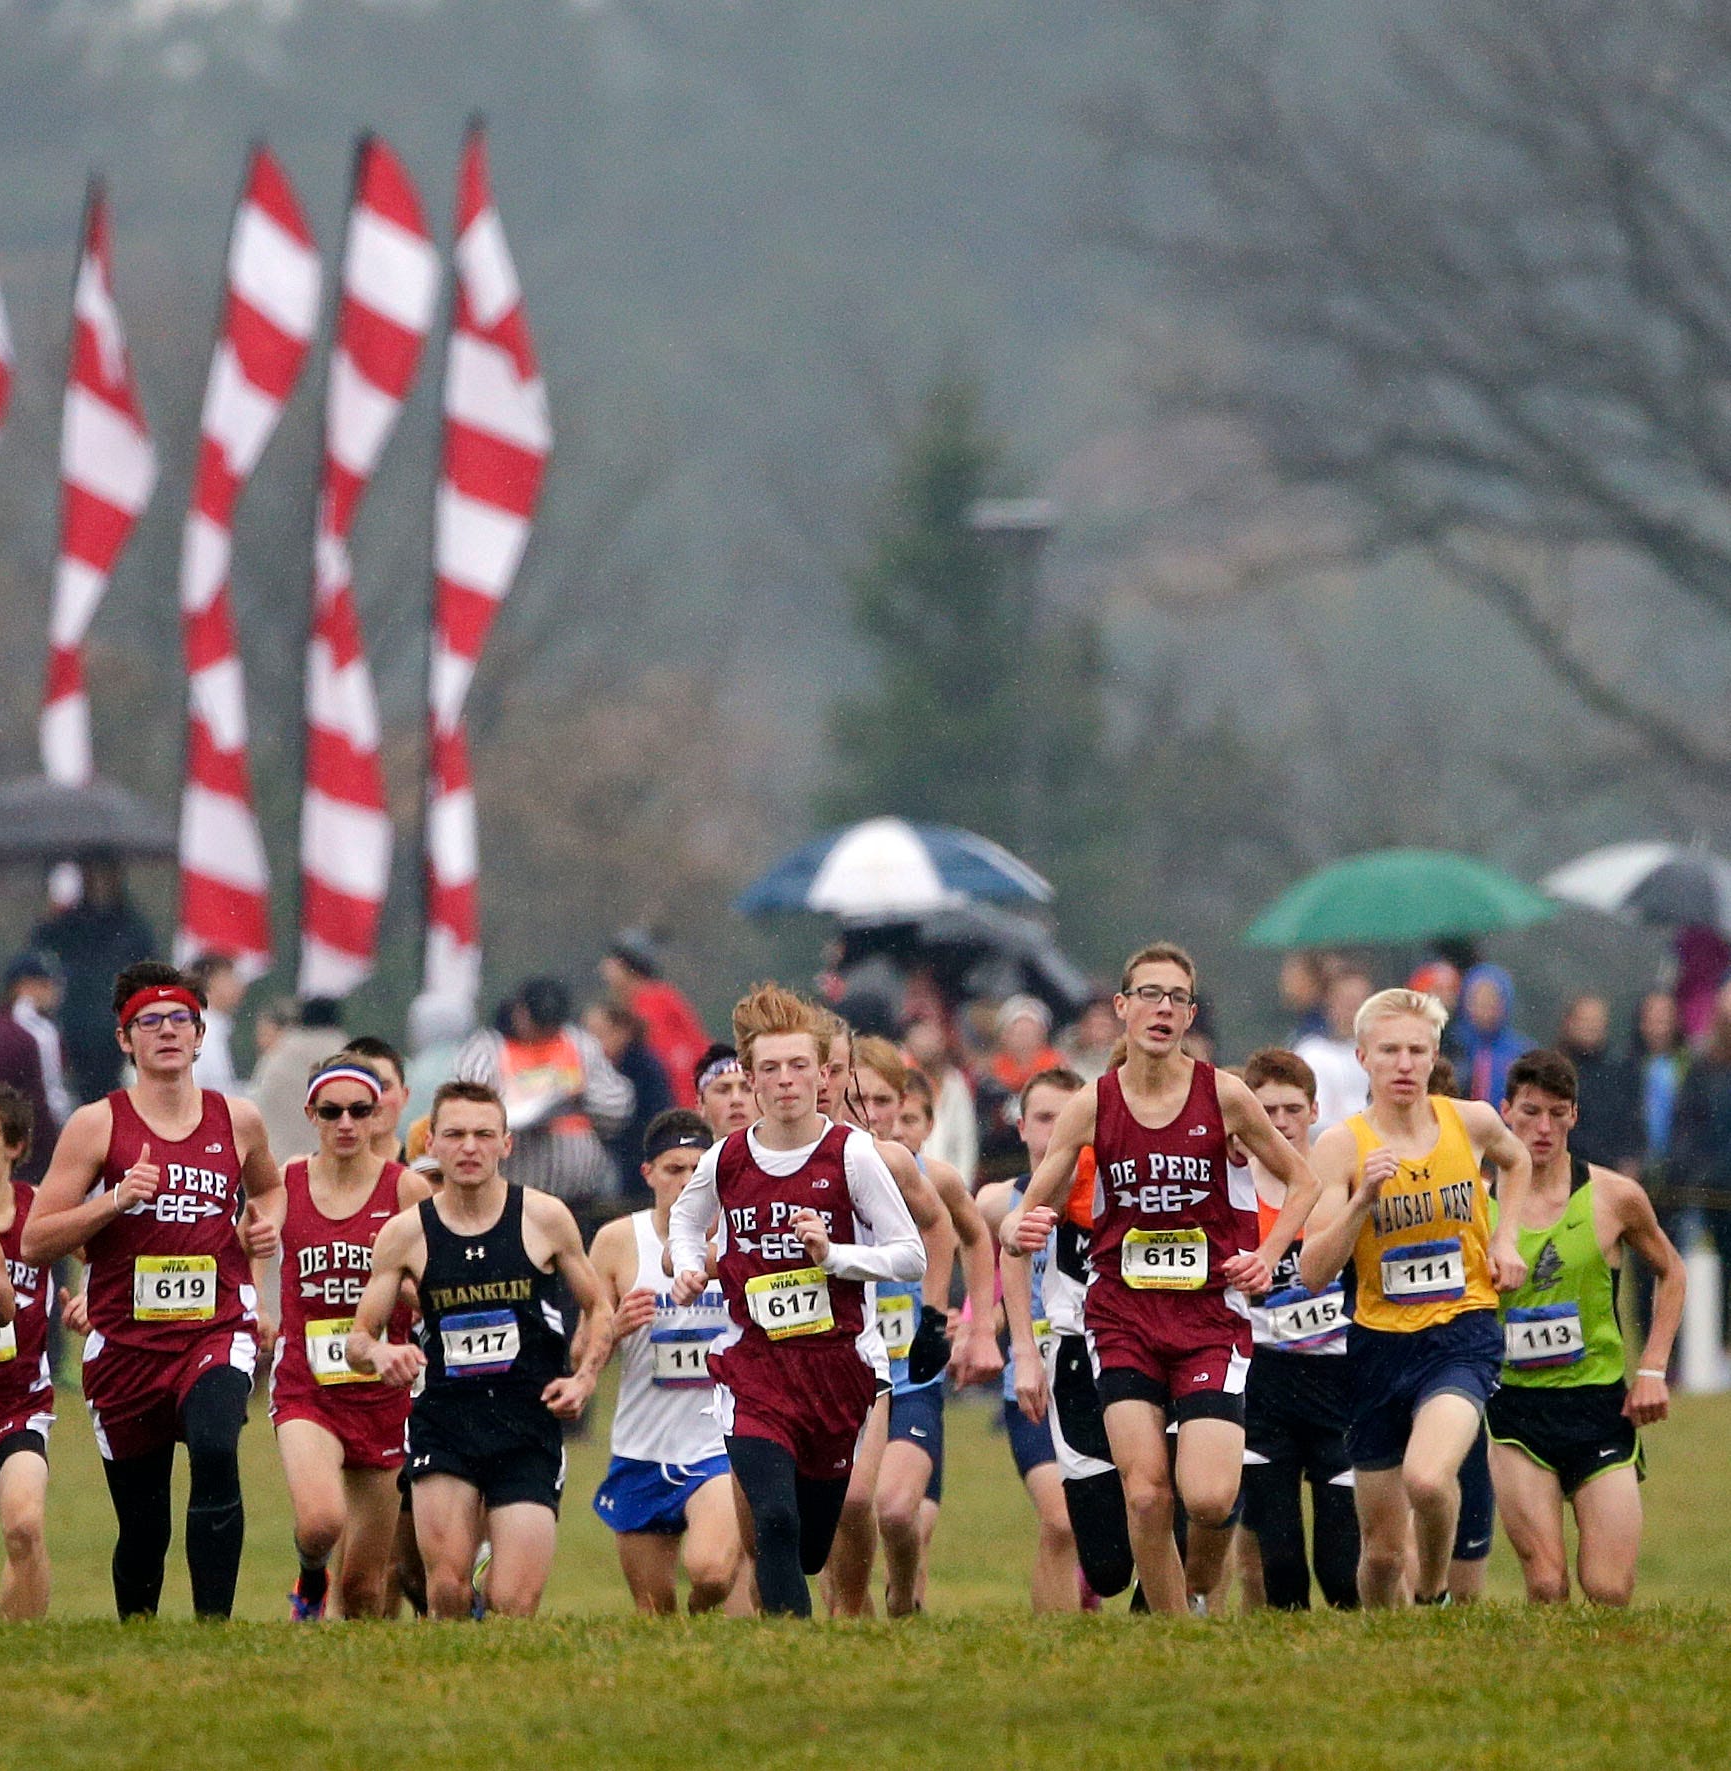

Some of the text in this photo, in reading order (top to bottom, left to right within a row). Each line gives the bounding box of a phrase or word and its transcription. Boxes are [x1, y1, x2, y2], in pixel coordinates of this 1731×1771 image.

[167, 1163, 228, 1199] PERE
[1109, 1152, 1211, 1188] DE PERE
[155, 1193, 197, 1223] CC
[1139, 1184, 1182, 1213] CC
[1371, 1180, 1474, 1238] WAUSAU WEST
[729, 1206, 757, 1234] DE
[298, 1241, 373, 1278] DE PER
[1144, 1247, 1196, 1266] 615
[770, 1279, 800, 1290] WIAA
[1404, 1261, 1450, 1283] 111
[155, 1279, 205, 1299] 619
[429, 1278, 532, 1310] FRANKLIN
[769, 1291, 818, 1317] 617
[1289, 1302, 1337, 1329] 115
[876, 1318, 901, 1339] 11
[1523, 1325, 1571, 1348] 113
[461, 1332, 508, 1354] 117
[671, 1348, 711, 1369] 11
